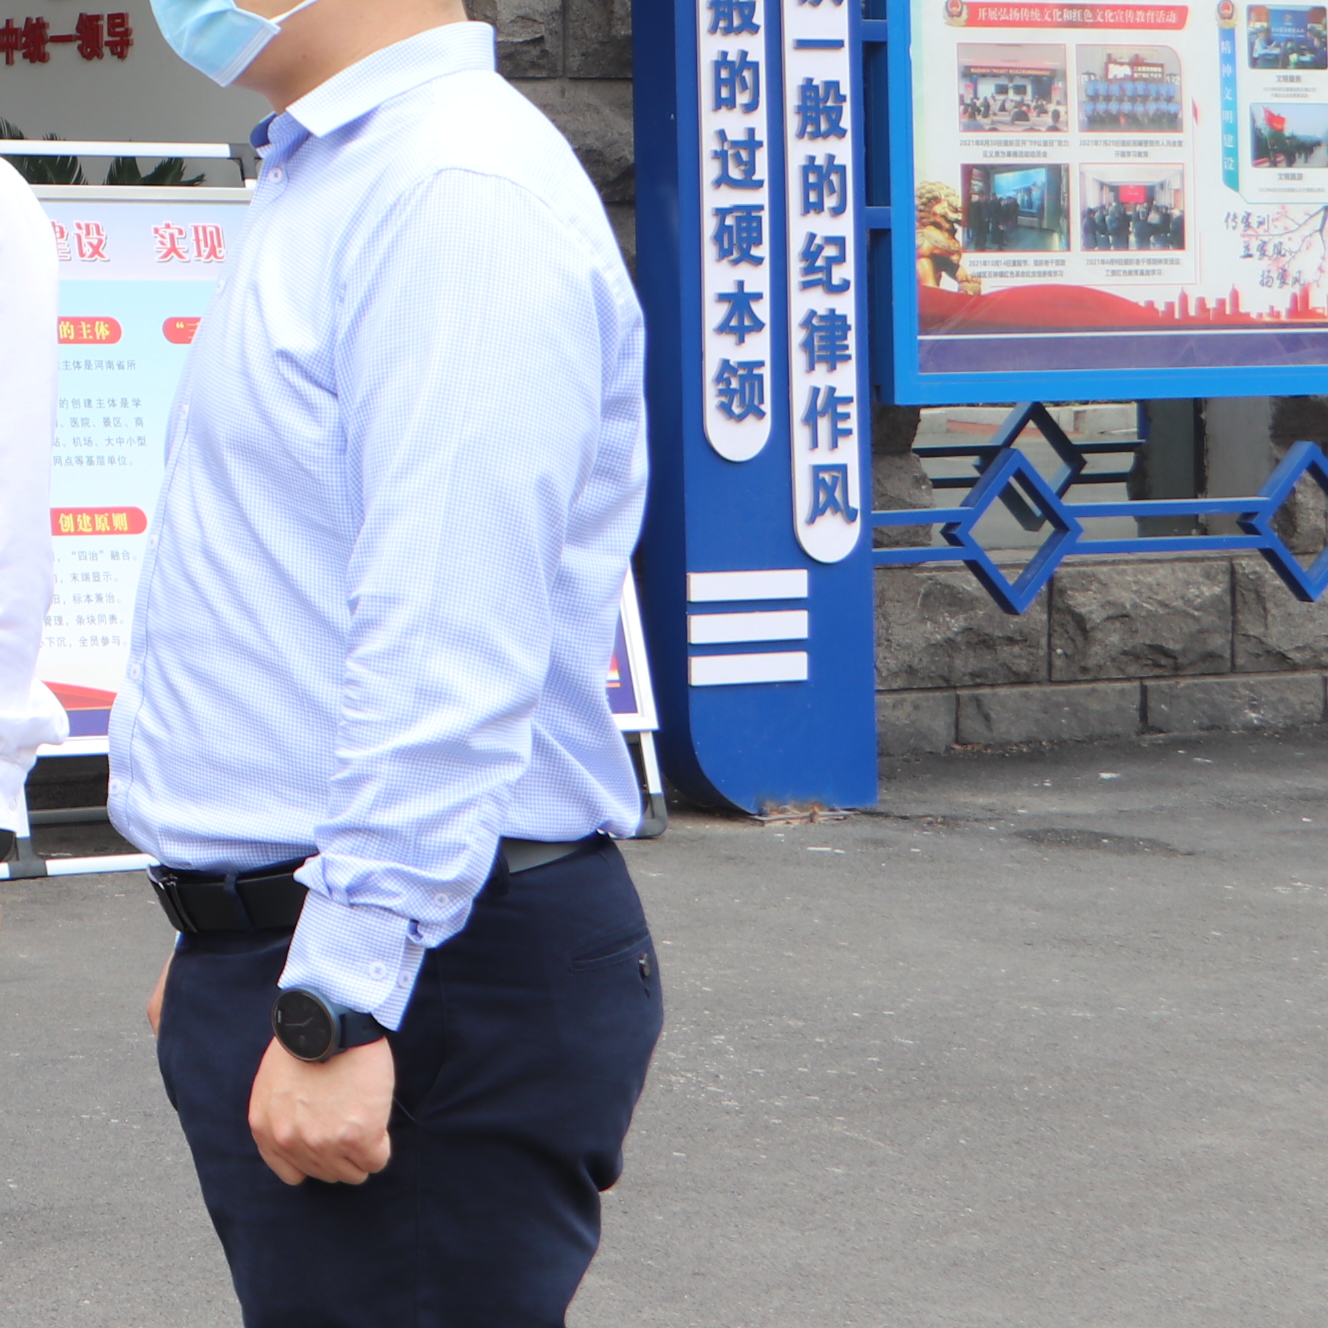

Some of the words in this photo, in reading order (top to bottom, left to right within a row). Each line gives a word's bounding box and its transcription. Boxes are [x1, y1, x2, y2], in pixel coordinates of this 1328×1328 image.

[153, 222, 226, 261] 实现
[59, 321, 111, 340] 的主体
[57, 359, 137, 371] 主体是河南省所
[55, 416, 145, 428] 、医院、景区、商
[58, 512, 129, 533] 创建原则
[54, 572, 118, 584] ，末端显示。
